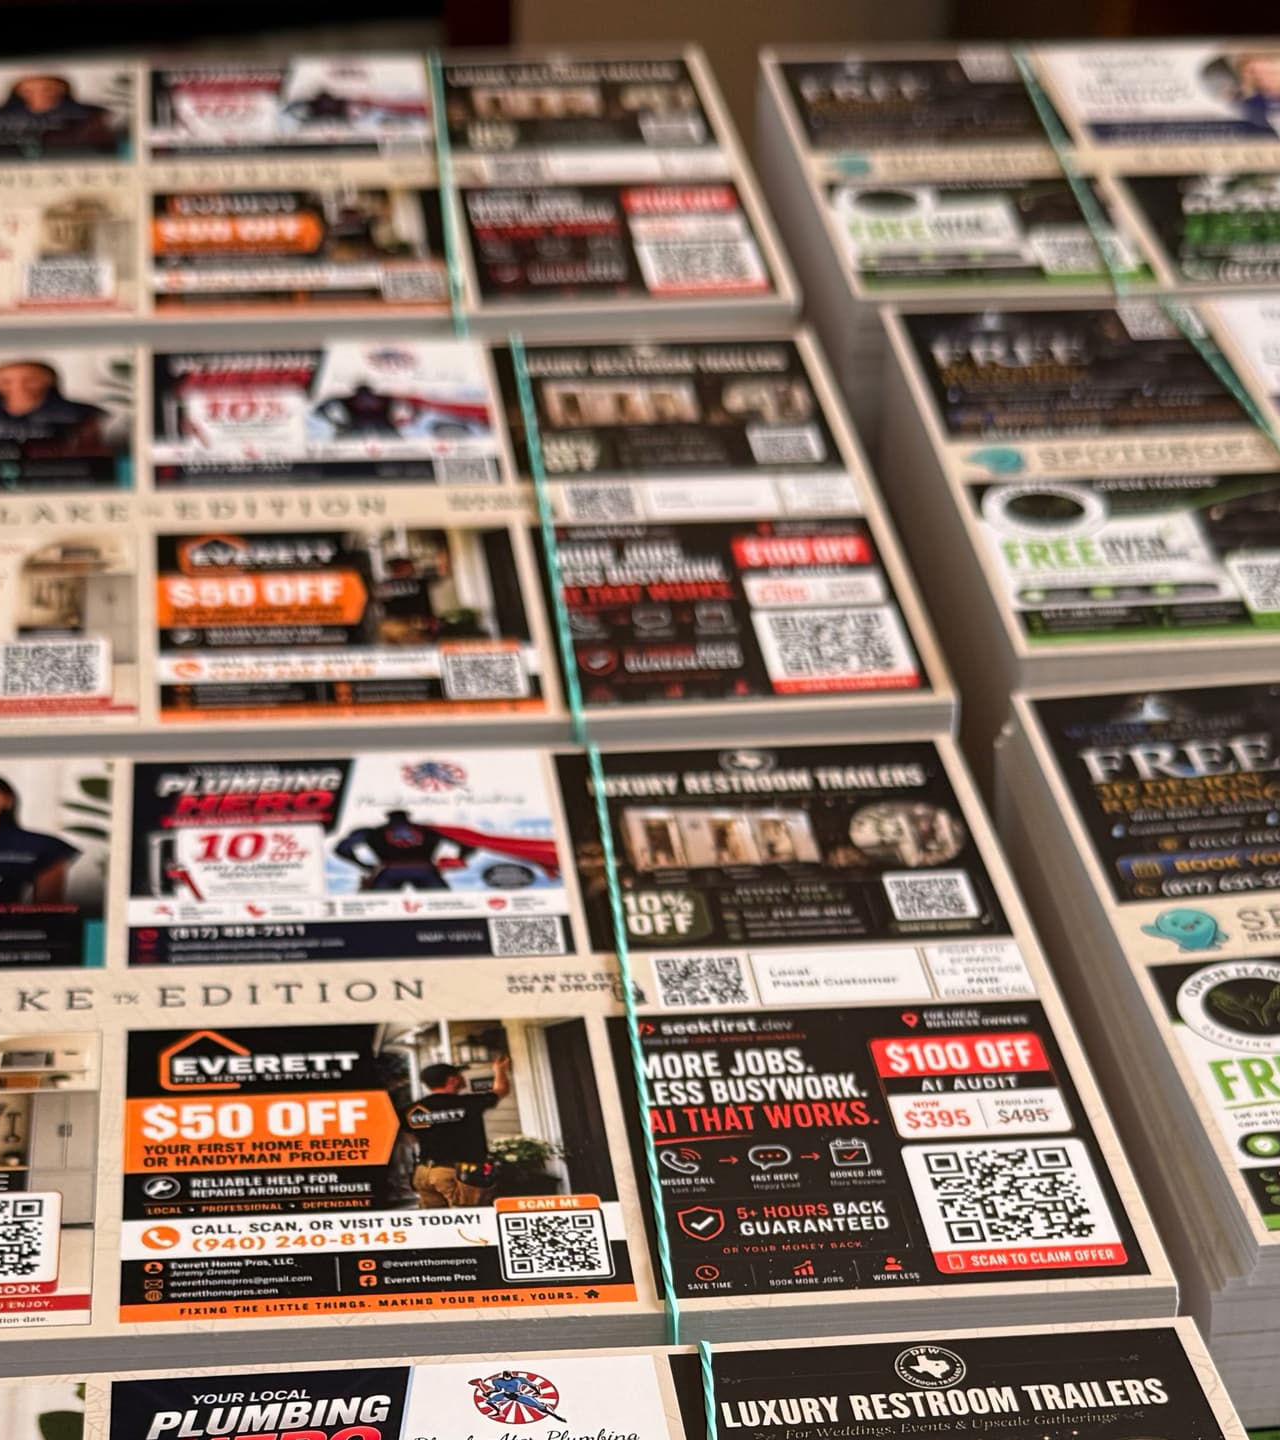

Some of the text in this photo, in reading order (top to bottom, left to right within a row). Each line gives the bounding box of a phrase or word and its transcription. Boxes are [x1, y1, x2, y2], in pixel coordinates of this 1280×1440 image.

[1002, 538, 1101, 570] FREE
[168, 576, 345, 608] $50 OFF
[160, 978, 427, 1009] EDITION
[172, 1053, 360, 1077] EVERETT
[884, 1038, 1035, 1074] $100 OFF
[141, 1098, 368, 1141] $50 OFF
[191, 1229, 408, 1251] (940) 240-8145
[191, 1388, 311, 1405] YOUR LOCAL
[720, 1379, 1169, 1429] LUXURY RESTROOM TRAILERS
[147, 1393, 392, 1440] PLUMBING
